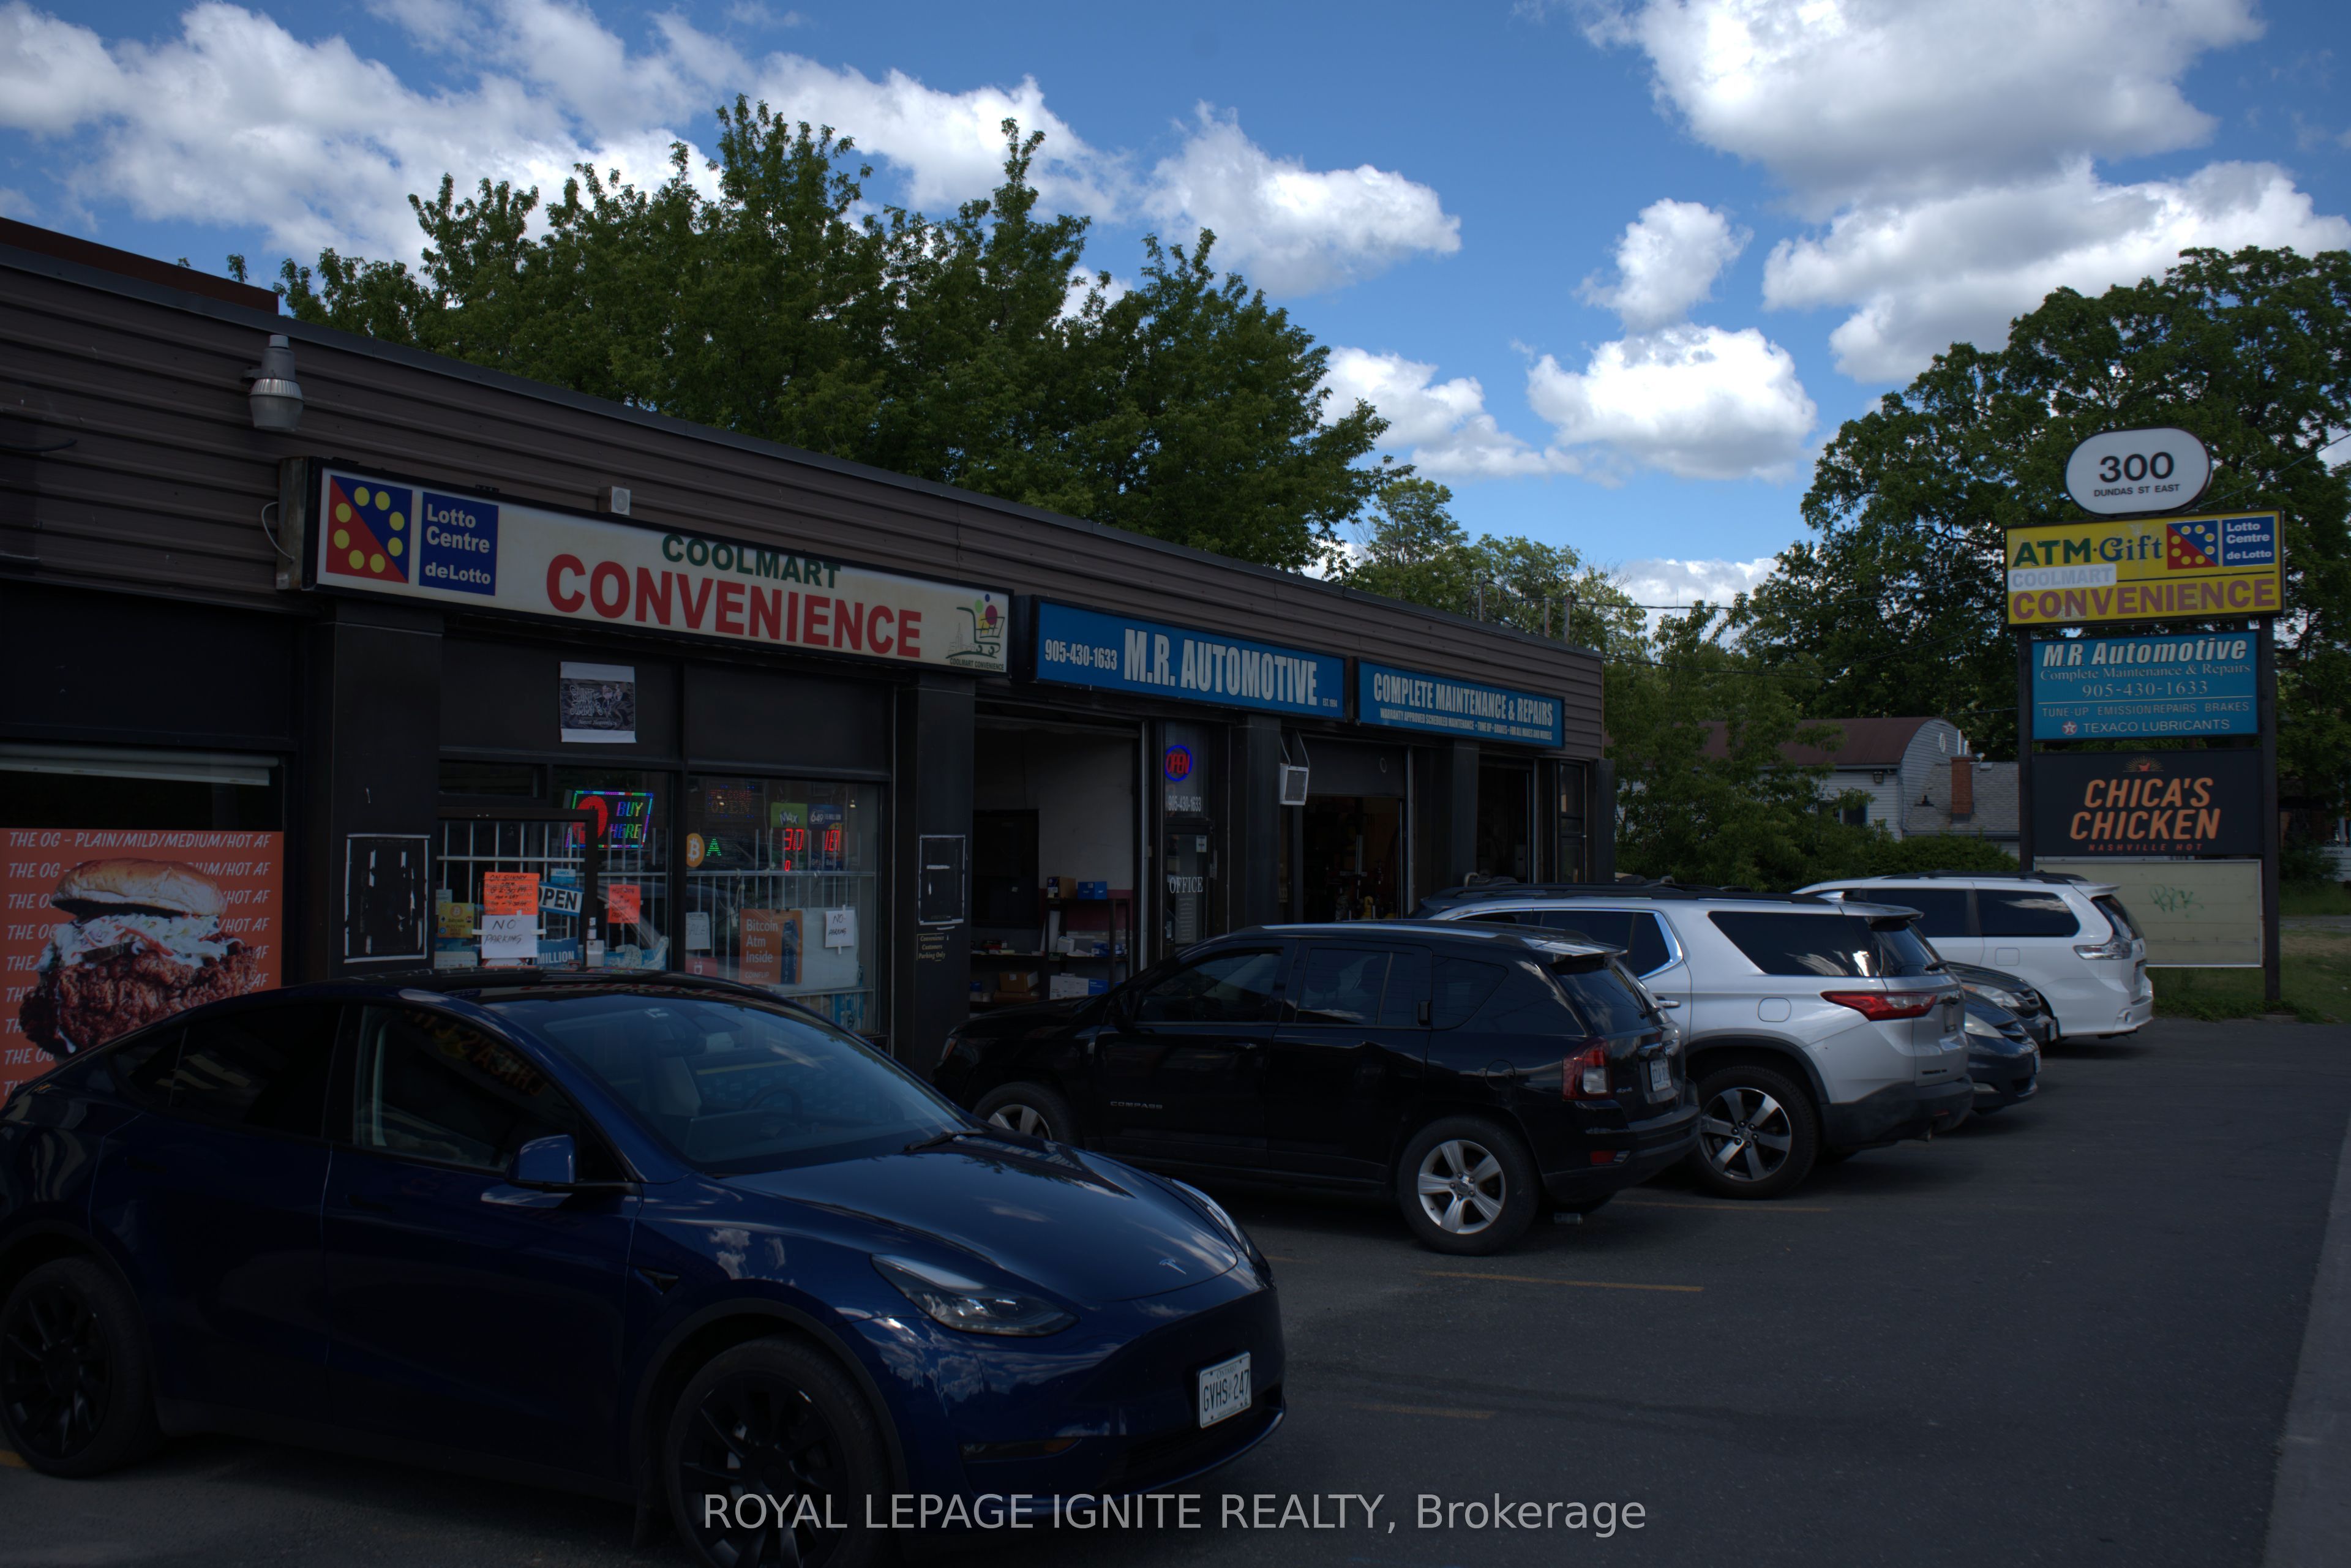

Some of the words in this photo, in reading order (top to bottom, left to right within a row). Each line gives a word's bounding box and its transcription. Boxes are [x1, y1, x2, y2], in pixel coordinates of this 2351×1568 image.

[2099, 452, 2174, 483] 300
[2094, 487, 2133, 497] DUNDAS
[2154, 484, 2180, 492] EAST
[427, 504, 476, 528] Lotto
[2226, 522, 2260, 532] Lotto
[427, 527, 490, 553] Centre
[2226, 533, 2270, 544] Centre
[662, 534, 841, 588] COOLMART
[2012, 567, 2112, 588] COOLMART
[546, 554, 921, 658] CONVENIENCE
[2013, 579, 2276, 619] CONVENIENCE
[2091, 637, 2247, 666] Automotive
[950, 658, 973, 667] COOLMART
[975, 661, 1004, 670] CONVENIENCE
[1044, 638, 1118, 671] 905-430-1633
[1123, 628, 1176, 687] M.R.
[1180, 639, 1318, 706] AUTOMOTIVE
[2041, 668, 2098, 682] Complete
[2103, 666, 2182, 678] Maintenance
[2186, 665, 2197, 675] &
[2203, 663, 2251, 677] Repairs
[2082, 681, 2208, 698] 905-430-1633
[1374, 673, 1433, 709] COMPLETE
[1436, 684, 1507, 719] MAINTENANCE
[1509, 700, 1515, 720] &
[1517, 698, 1553, 727] REPAIRS
[1380, 708, 1404, 720] WARRANTY
[1404, 711, 1425, 724] APPROVED
[1425, 714, 1448, 726] SCHEDULED
[2042, 707, 2089, 717] TUNE-UP
[2098, 705, 2151, 716] EMISSION
[2153, 703, 2197, 714] REPAIRS
[2205, 702, 2249, 712] BRAKES
[2082, 722, 2139, 733] TEXACO
[2142, 719, 2230, 731] LUBRICANTS
[1166, 754, 1190, 774] OPEN
[2083, 777, 2214, 808] CHICA'S
[617, 801, 643, 817] BUY
[1168, 795, 1201, 812] 905-430-1633
[779, 809, 799, 825] MAX
[811, 810, 823, 823] 649
[2069, 808, 2221, 840] CHICKEN
[610, 824, 642, 838] HERE
[9, 831, 37, 848] THE
[40, 832, 61, 847] OG
[75, 833, 253, 849] PLAIN/MILD/MEDIUM/HOT
[253, 834, 271, 848] AF
[706, 838, 722, 857] A
[9, 862, 36, 878] THE
[39, 863, 61, 877] OG
[253, 862, 271, 876] AF
[784, 860, 791, 871] 0
[1169, 877, 1203, 893] OFFICE
[8, 893, 36, 909] THE
[39, 894, 55, 907] O
[252, 890, 270, 904] AF
[7, 925, 35, 940] THE
[252, 917, 269, 931] AF
[492, 919, 516, 929] NO
[746, 919, 778, 931] Bitcoin
[484, 934, 523, 945] PARKING
[746, 934, 766, 947] Atm
[7, 956, 35, 971] THE
[538, 950, 575, 964] MILLION
[746, 950, 773, 962] Inside
[252, 973, 269, 987] AF
[4, 1049, 32, 1065] THE
[1110, 1101, 1163, 1109] COMPASS
[1217, 1365, 1237, 1379] ONTARIO
